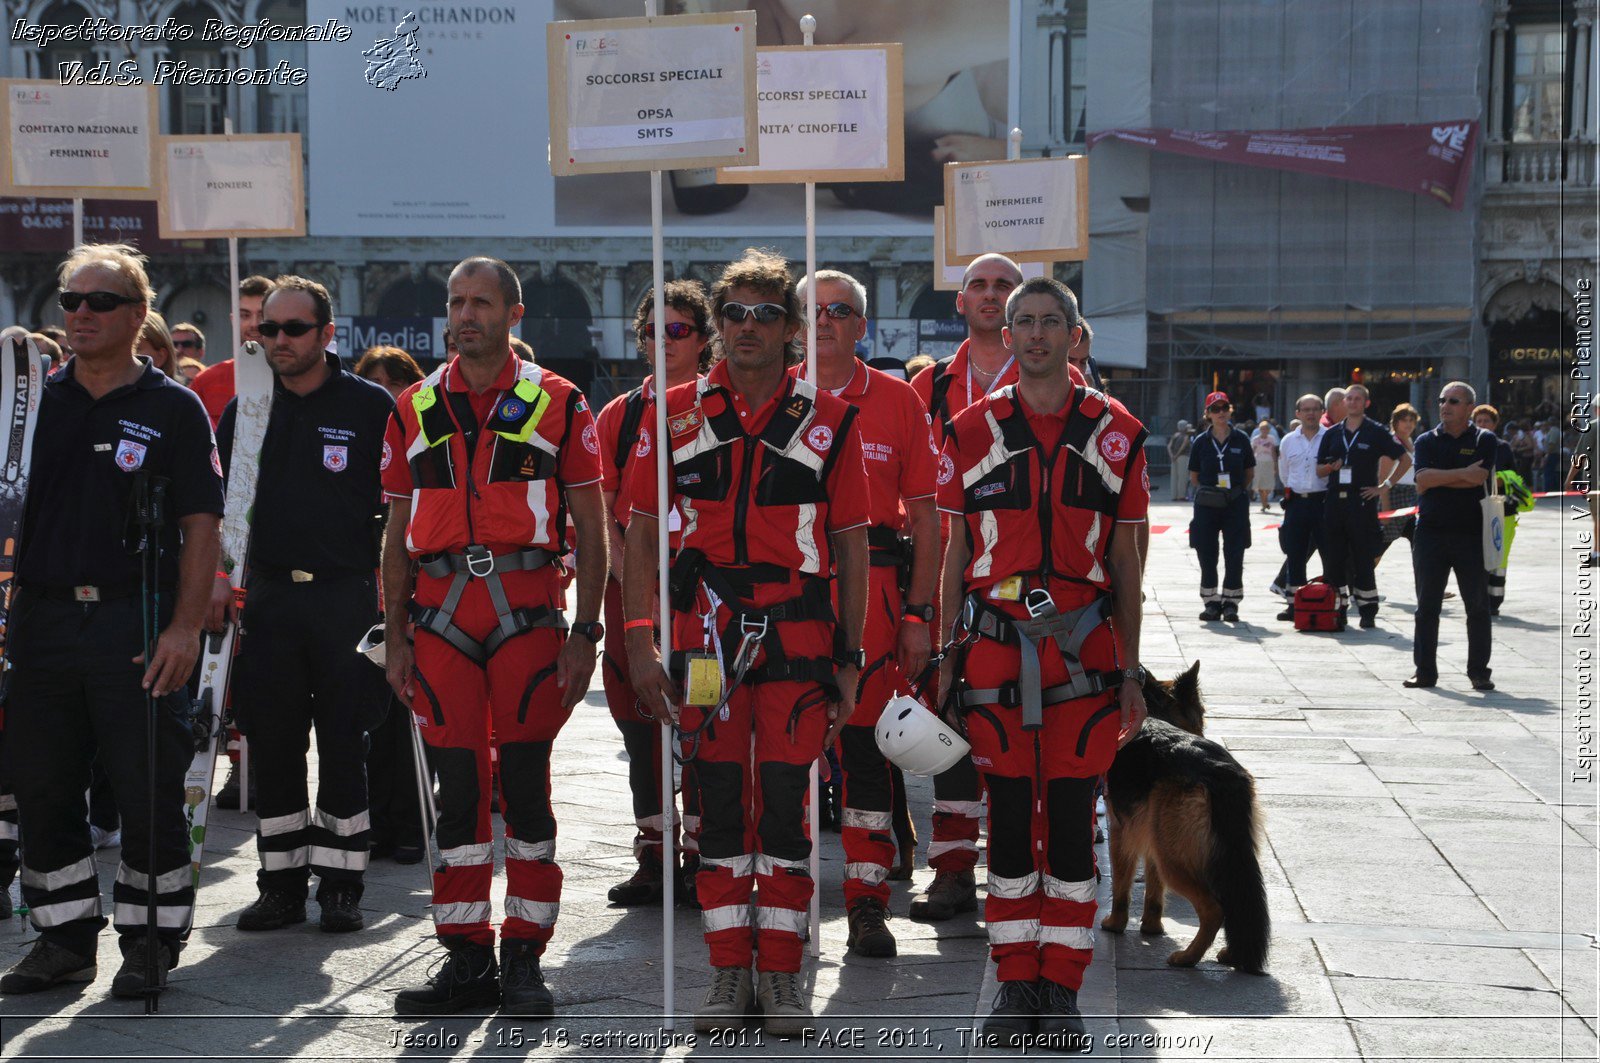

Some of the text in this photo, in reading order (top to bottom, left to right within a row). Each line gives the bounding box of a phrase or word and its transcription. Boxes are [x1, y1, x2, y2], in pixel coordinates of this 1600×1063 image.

[419, 7, 516, 23] CHANDON
[586, 68, 722, 85] SOCCORSI SPECIALI
[758, 90, 867, 101] CCORSI SPECIALI
[637, 108, 673, 120] OPSA
[19, 125, 138, 135] COMITATO NAZIONALE
[637, 127, 673, 139] SMTS
[760, 123, 858, 134] NITA' CINOFILE
[50, 149, 109, 158] FEMMINILE
[206, 181, 253, 189] PIONIERI
[986, 196, 1043, 207] INFERMIERE
[109, 216, 142, 229] 2011
[985, 217, 1044, 228] VOLONTARIE
[354, 326, 430, 350] Media
[118, 419, 162, 438] CROCE ROSSA
[123, 427, 151, 441] ITALIANA
[318, 426, 336, 434] CROCE
